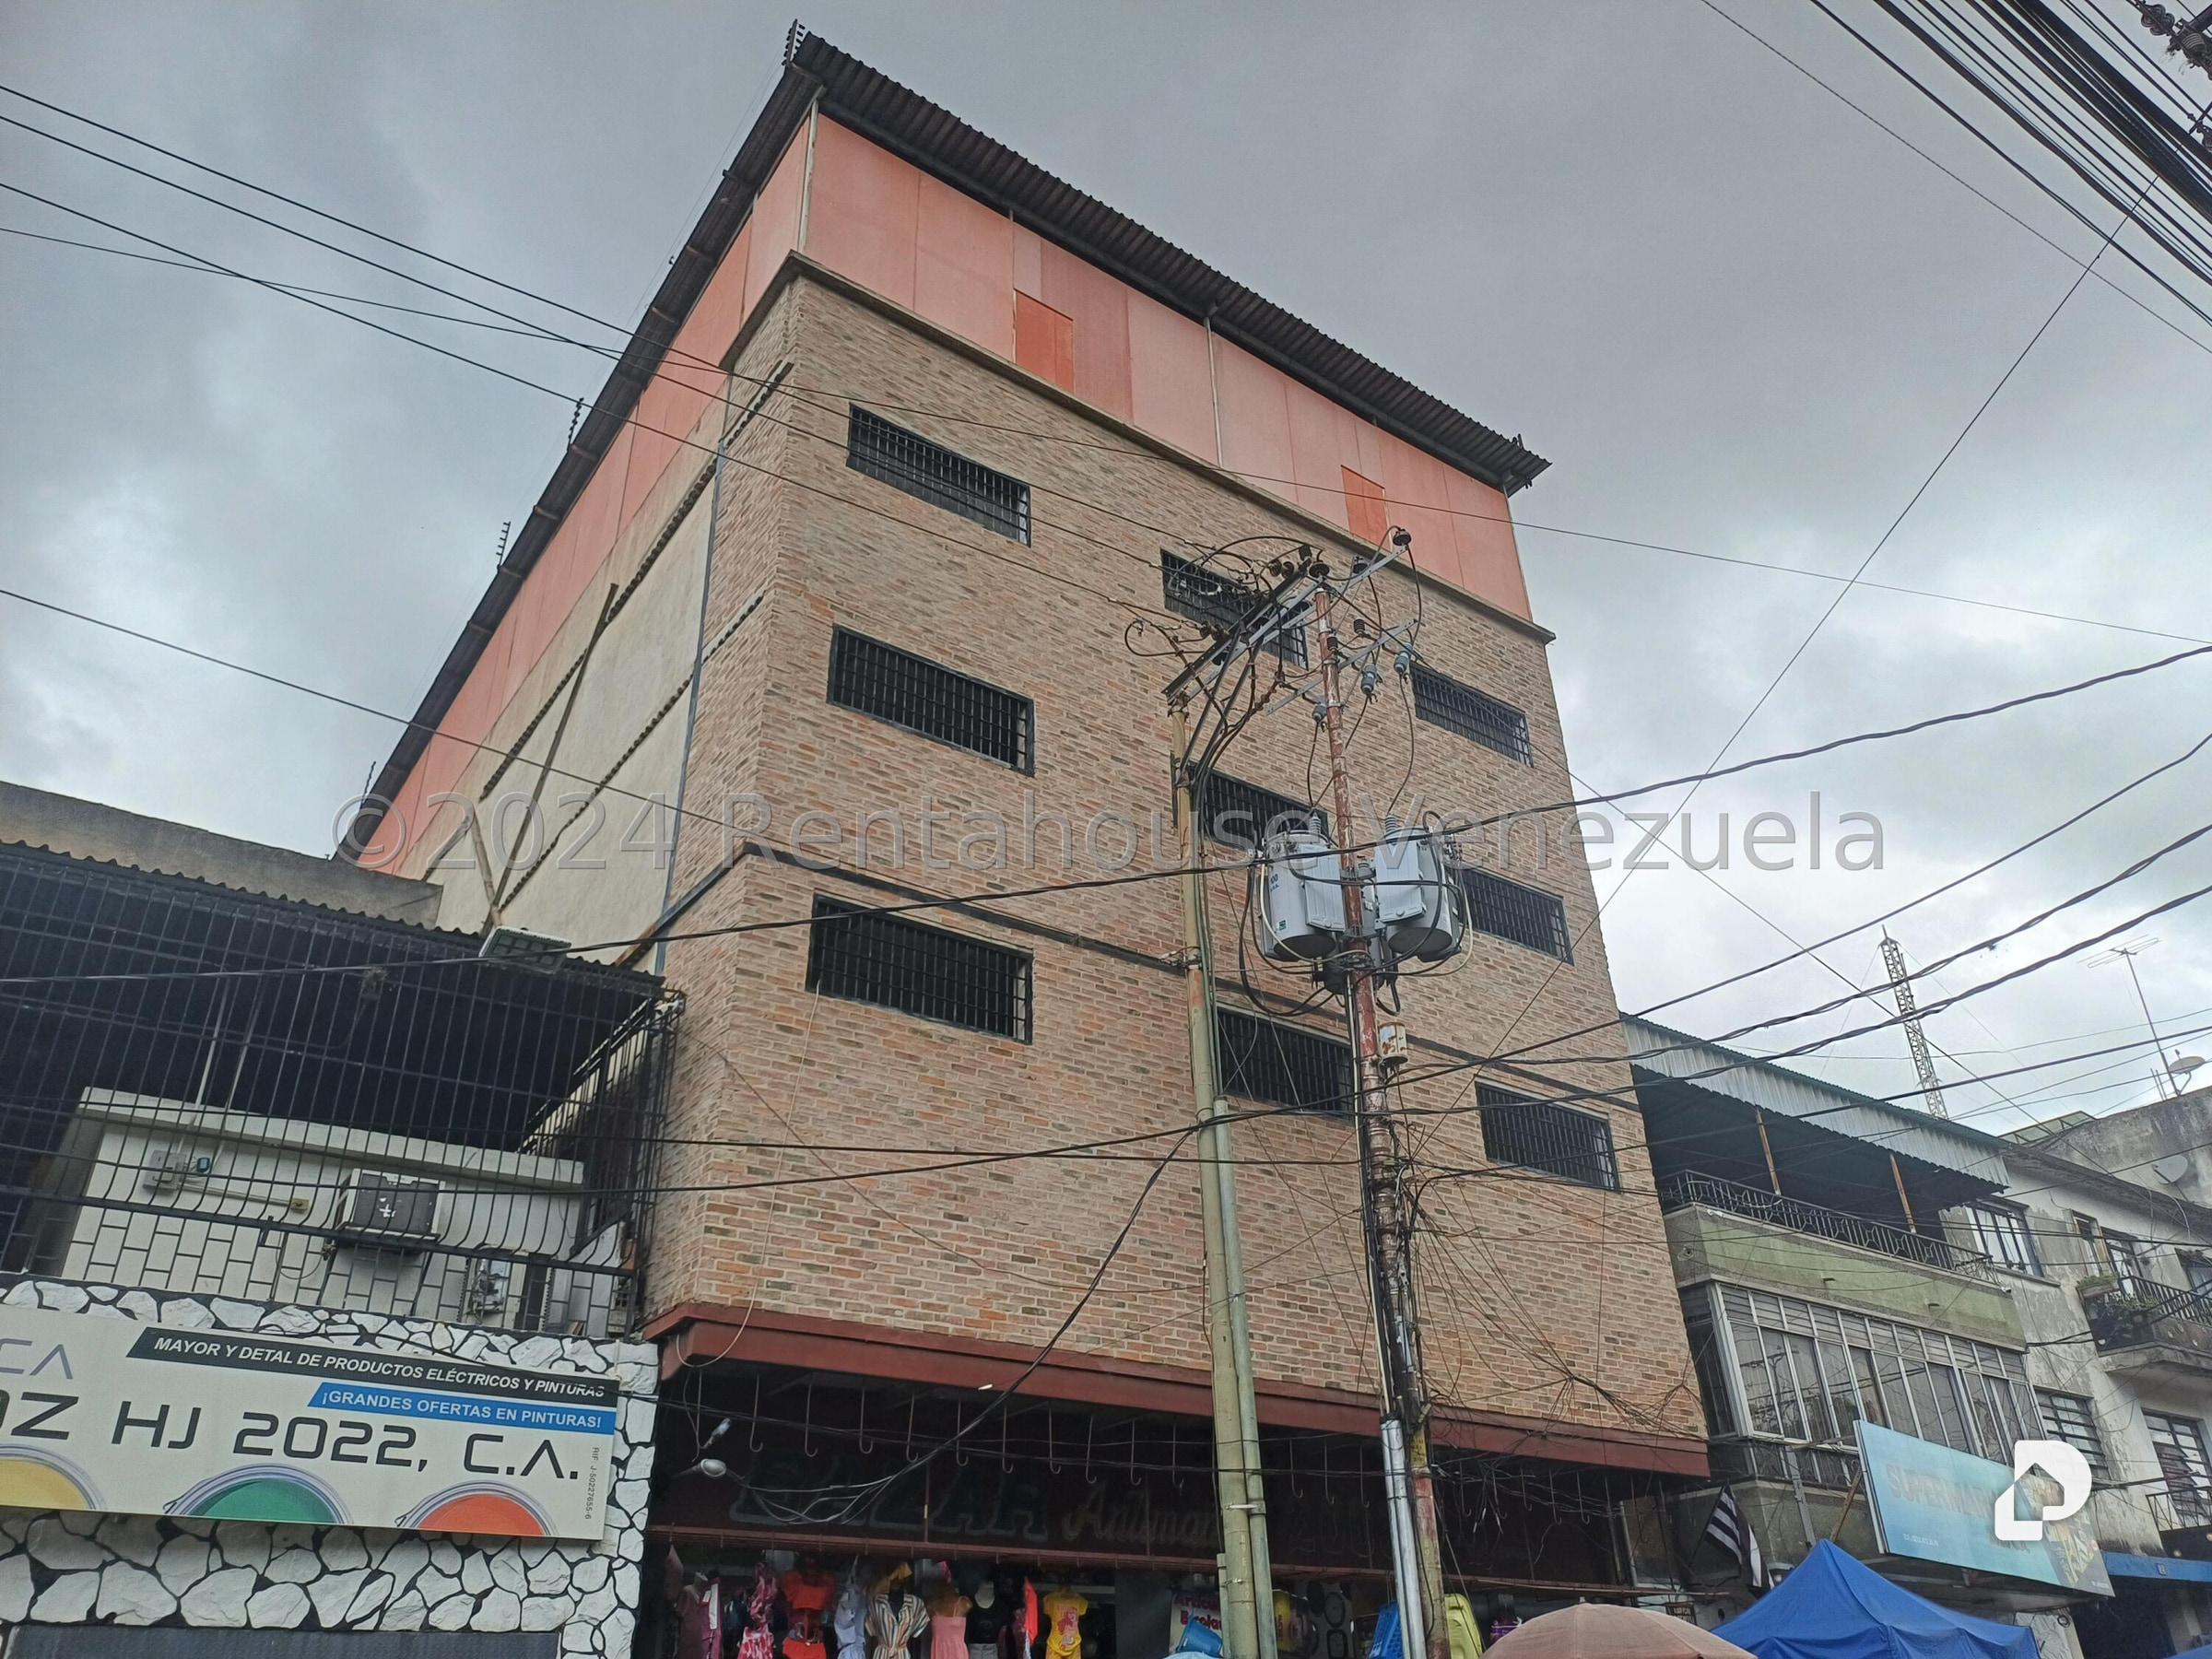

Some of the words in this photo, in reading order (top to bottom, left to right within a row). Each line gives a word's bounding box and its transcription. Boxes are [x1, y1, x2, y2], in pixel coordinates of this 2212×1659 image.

[154, 1336, 220, 1357] MAYOR
[225, 1345, 240, 1358] Y
[238, 1347, 293, 1364] DETAL
[297, 1352, 323, 1368] DE
[324, 1356, 423, 1379] PRODUCTOS
[426, 1368, 520, 1390] ELÉCTRICOS
[524, 1379, 536, 1391] Y
[536, 1381, 606, 1398] PINTURAS
[111, 1400, 202, 1450] HJ
[232, 1411, 428, 1473] 2022,
[463, 1432, 580, 1480] C.A.
[322, 1389, 413, 1411] ¡GRANDES
[417, 1399, 492, 1418] OFERTAS
[496, 1407, 518, 1421] EN
[521, 1410, 603, 1429] PINTURAS!
